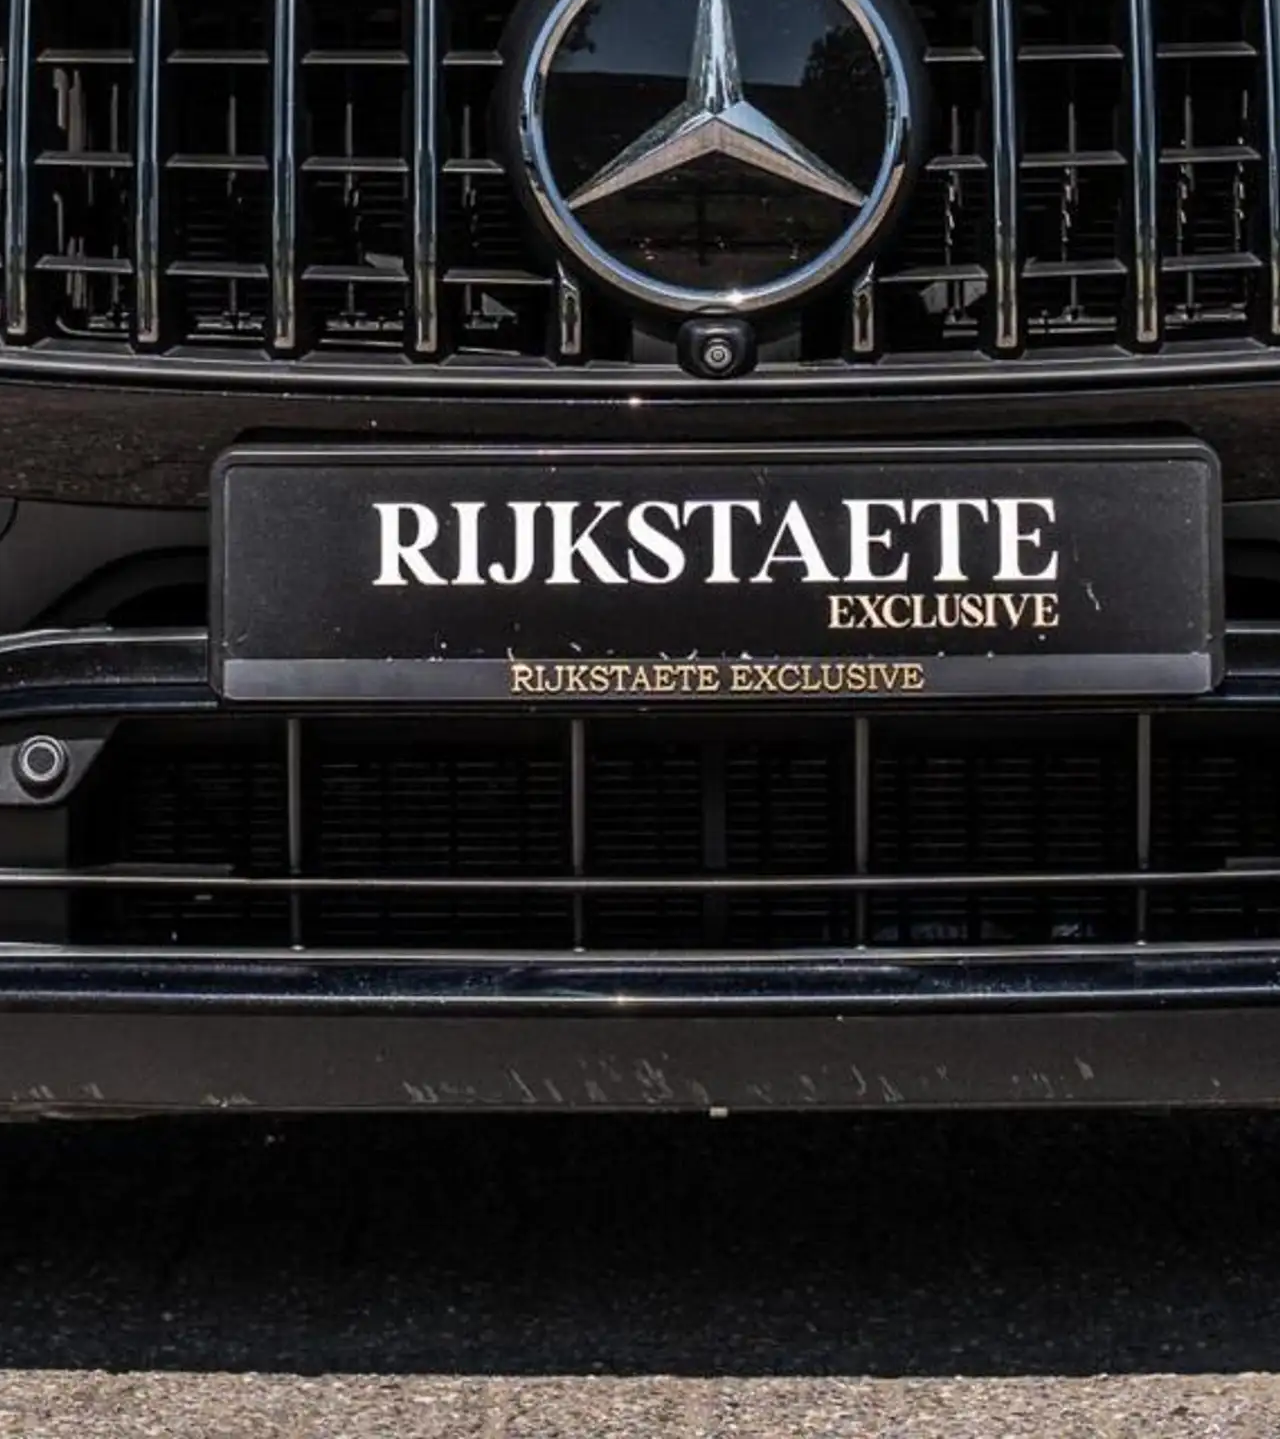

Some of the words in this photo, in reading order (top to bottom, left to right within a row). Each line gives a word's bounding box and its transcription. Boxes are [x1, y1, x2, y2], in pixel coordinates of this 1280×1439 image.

[372, 498, 1059, 586] RIJKSTAETE
[827, 593, 1060, 629] EXCLUSIVE
[510, 664, 721, 693] RIJKSTAETE
[730, 663, 926, 693] EXCLUSIVE
